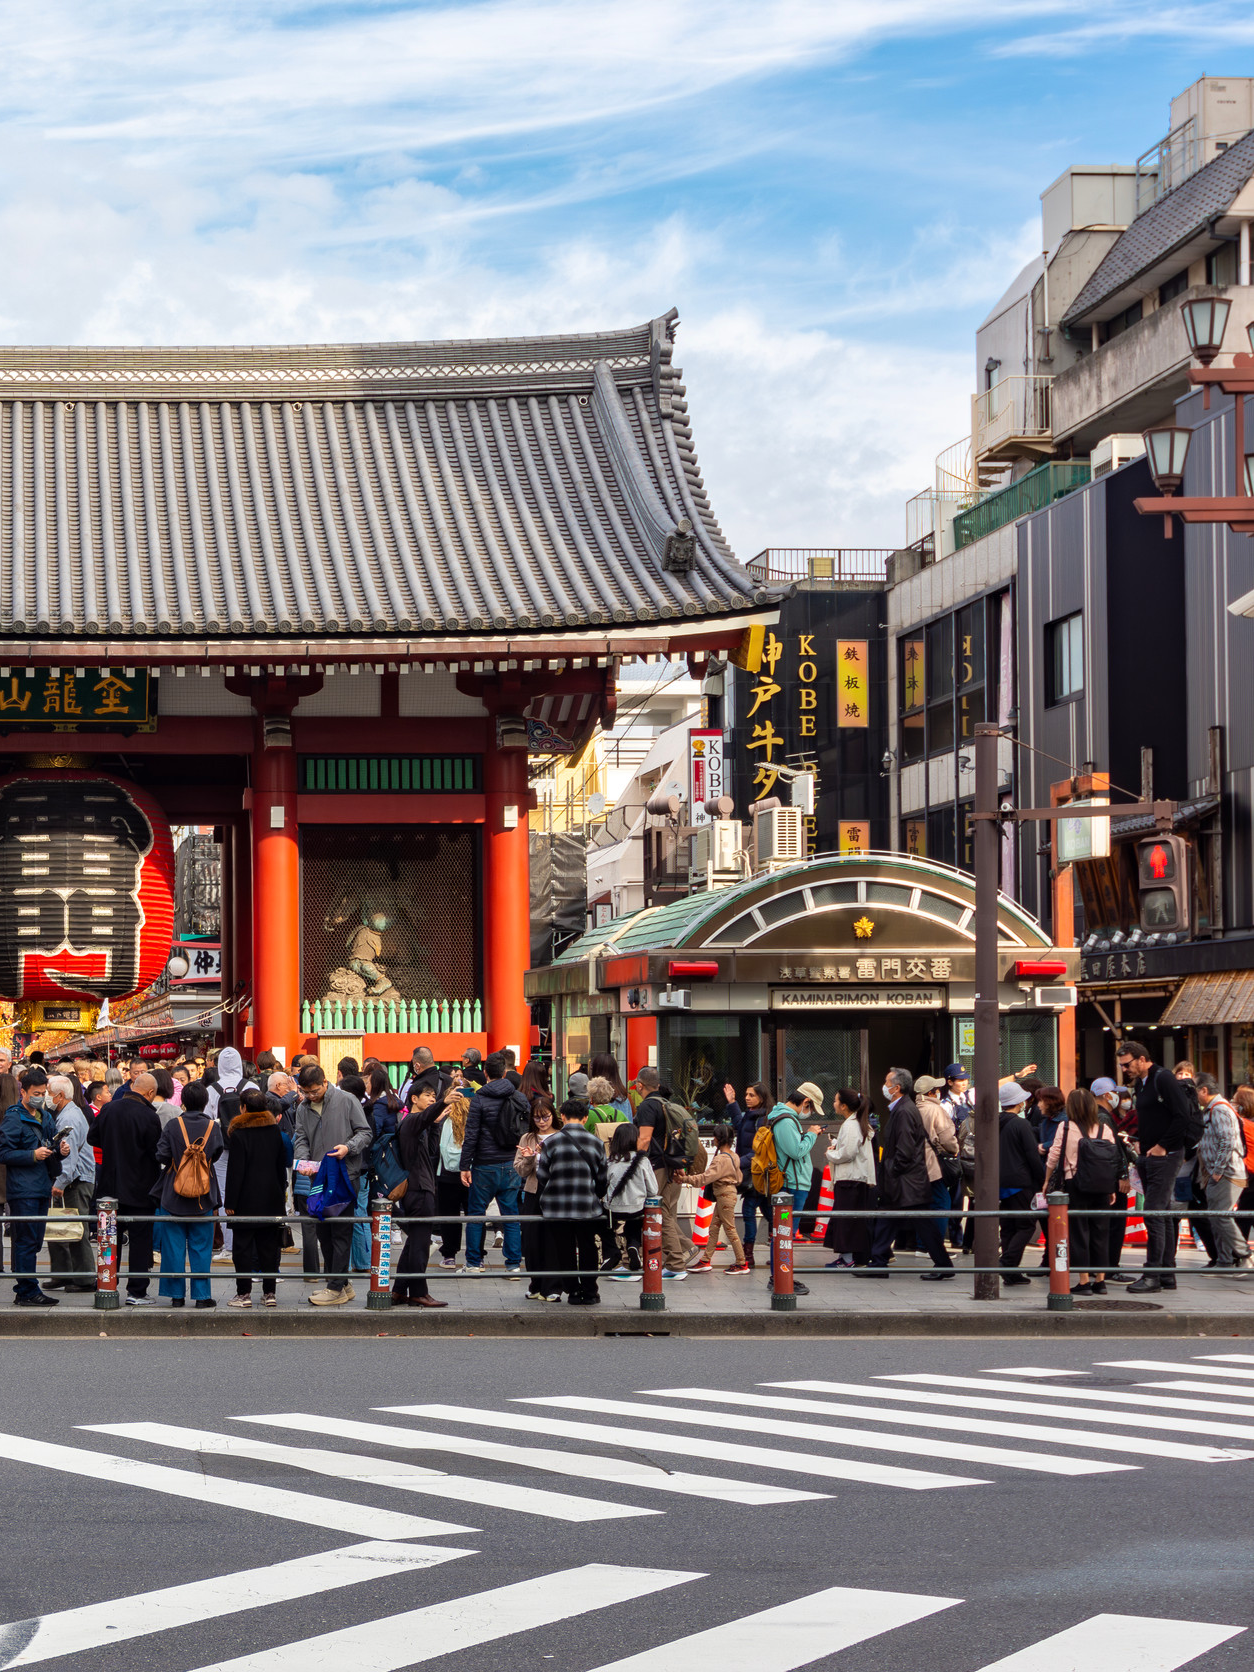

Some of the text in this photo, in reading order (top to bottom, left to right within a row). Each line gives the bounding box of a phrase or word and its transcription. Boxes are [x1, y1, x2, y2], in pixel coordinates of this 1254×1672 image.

[798, 634, 818, 737] KOBE
[844, 647, 860, 718] 鉄板焼
[194, 950, 221, 975] 仲
[779, 957, 952, 980] 浅草警察署 雷門交番
[781, 993, 933, 1005] KAMINARIMON KOBAN
